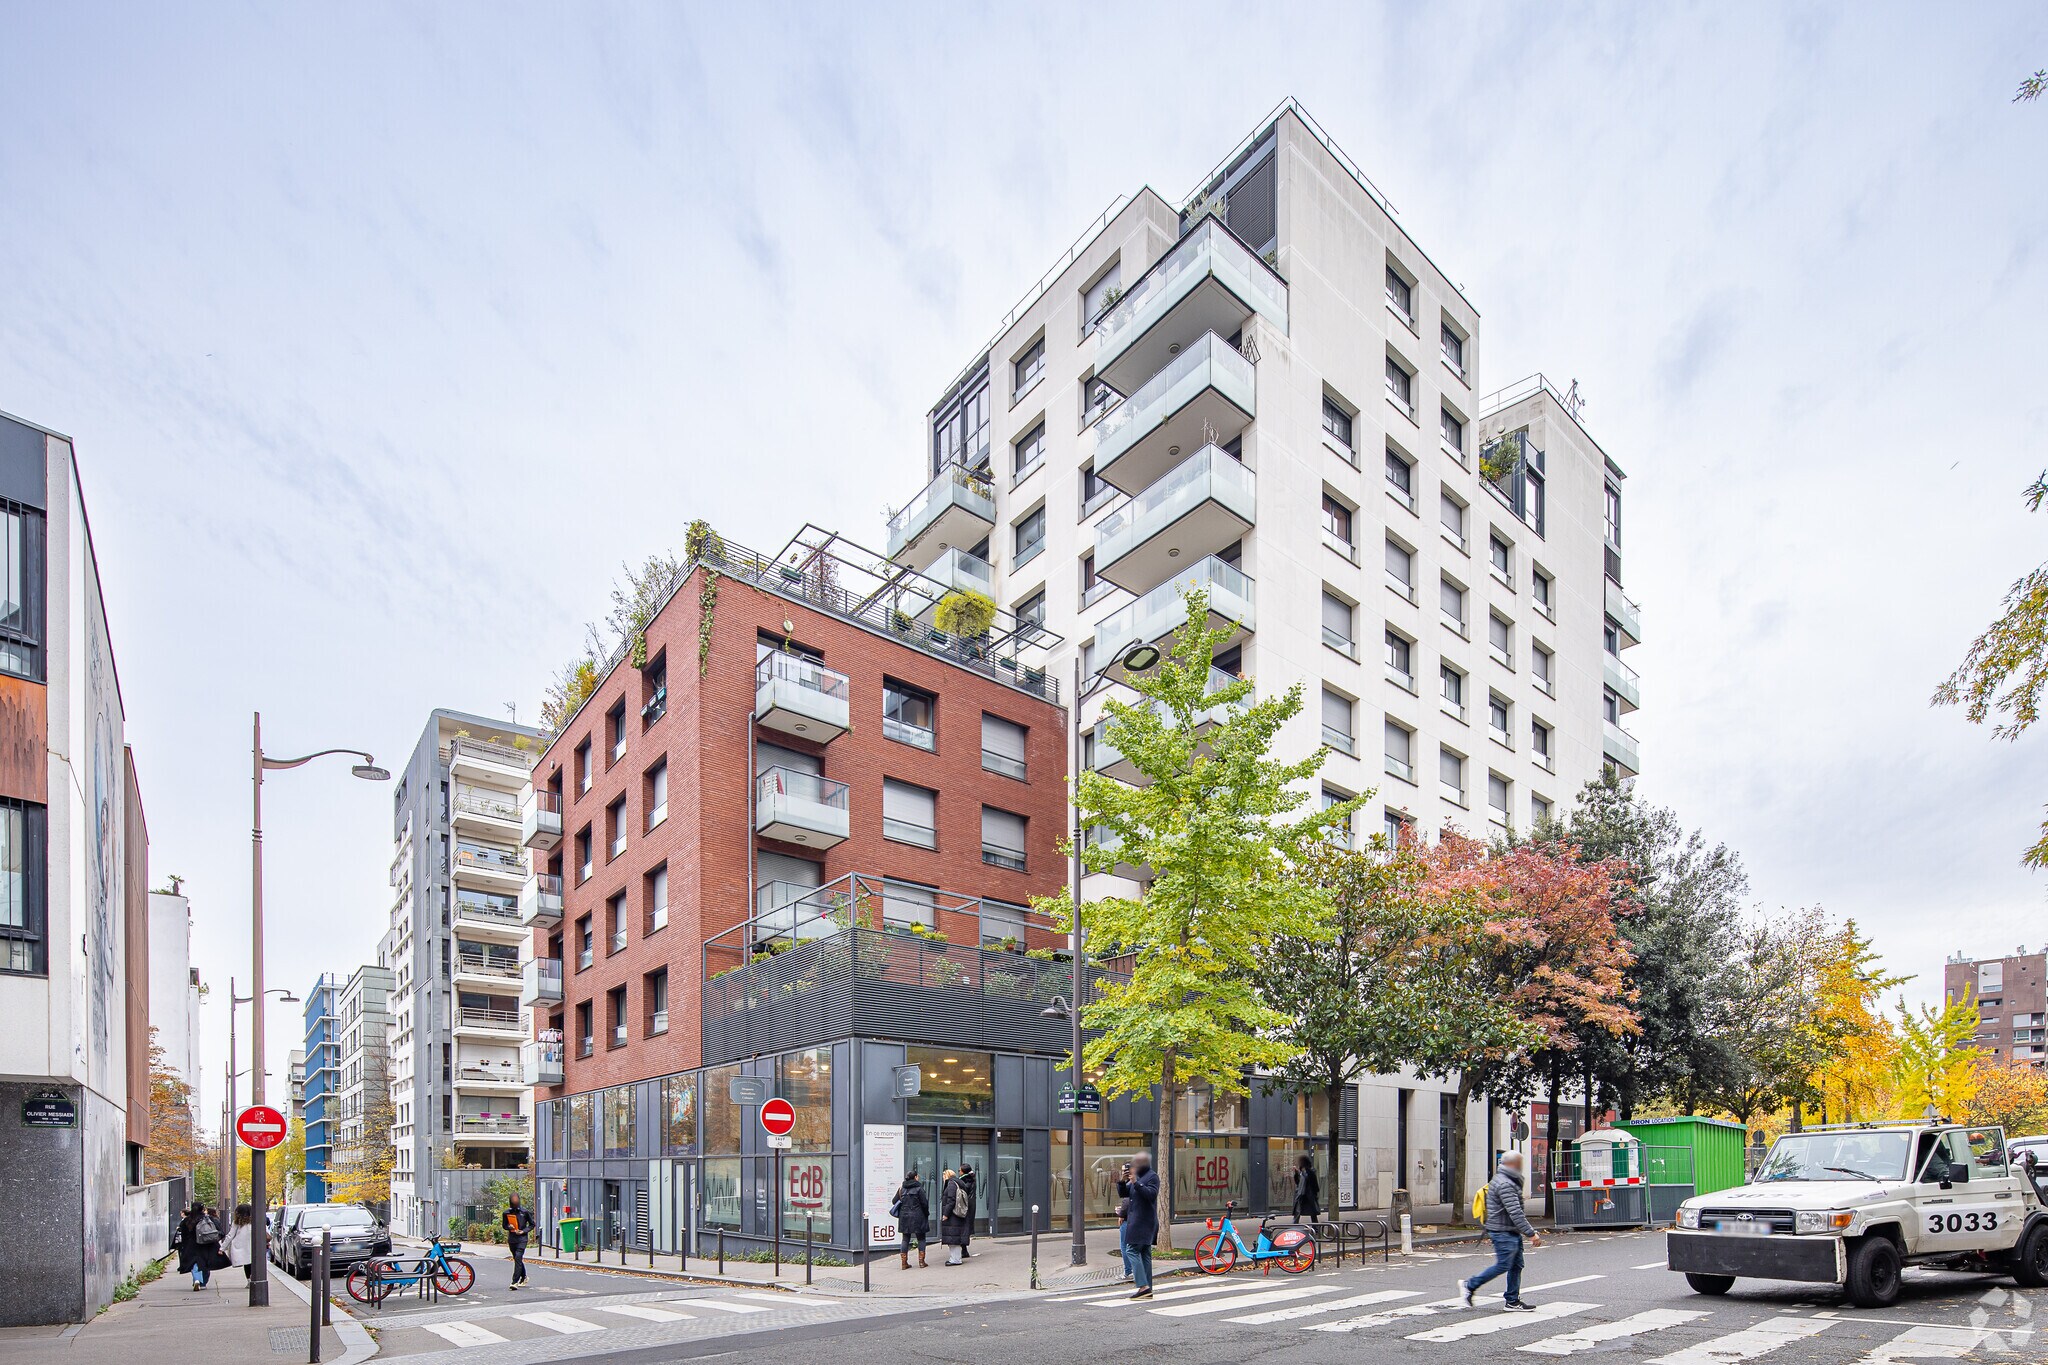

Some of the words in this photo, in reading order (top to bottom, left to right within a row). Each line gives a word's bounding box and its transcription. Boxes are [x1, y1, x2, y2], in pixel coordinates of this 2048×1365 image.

[1196, 1156, 1230, 1182] EdB
[790, 1165, 823, 1198] EdB
[873, 1225, 896, 1238] EdB
[1928, 1212, 1998, 1234] 3033
